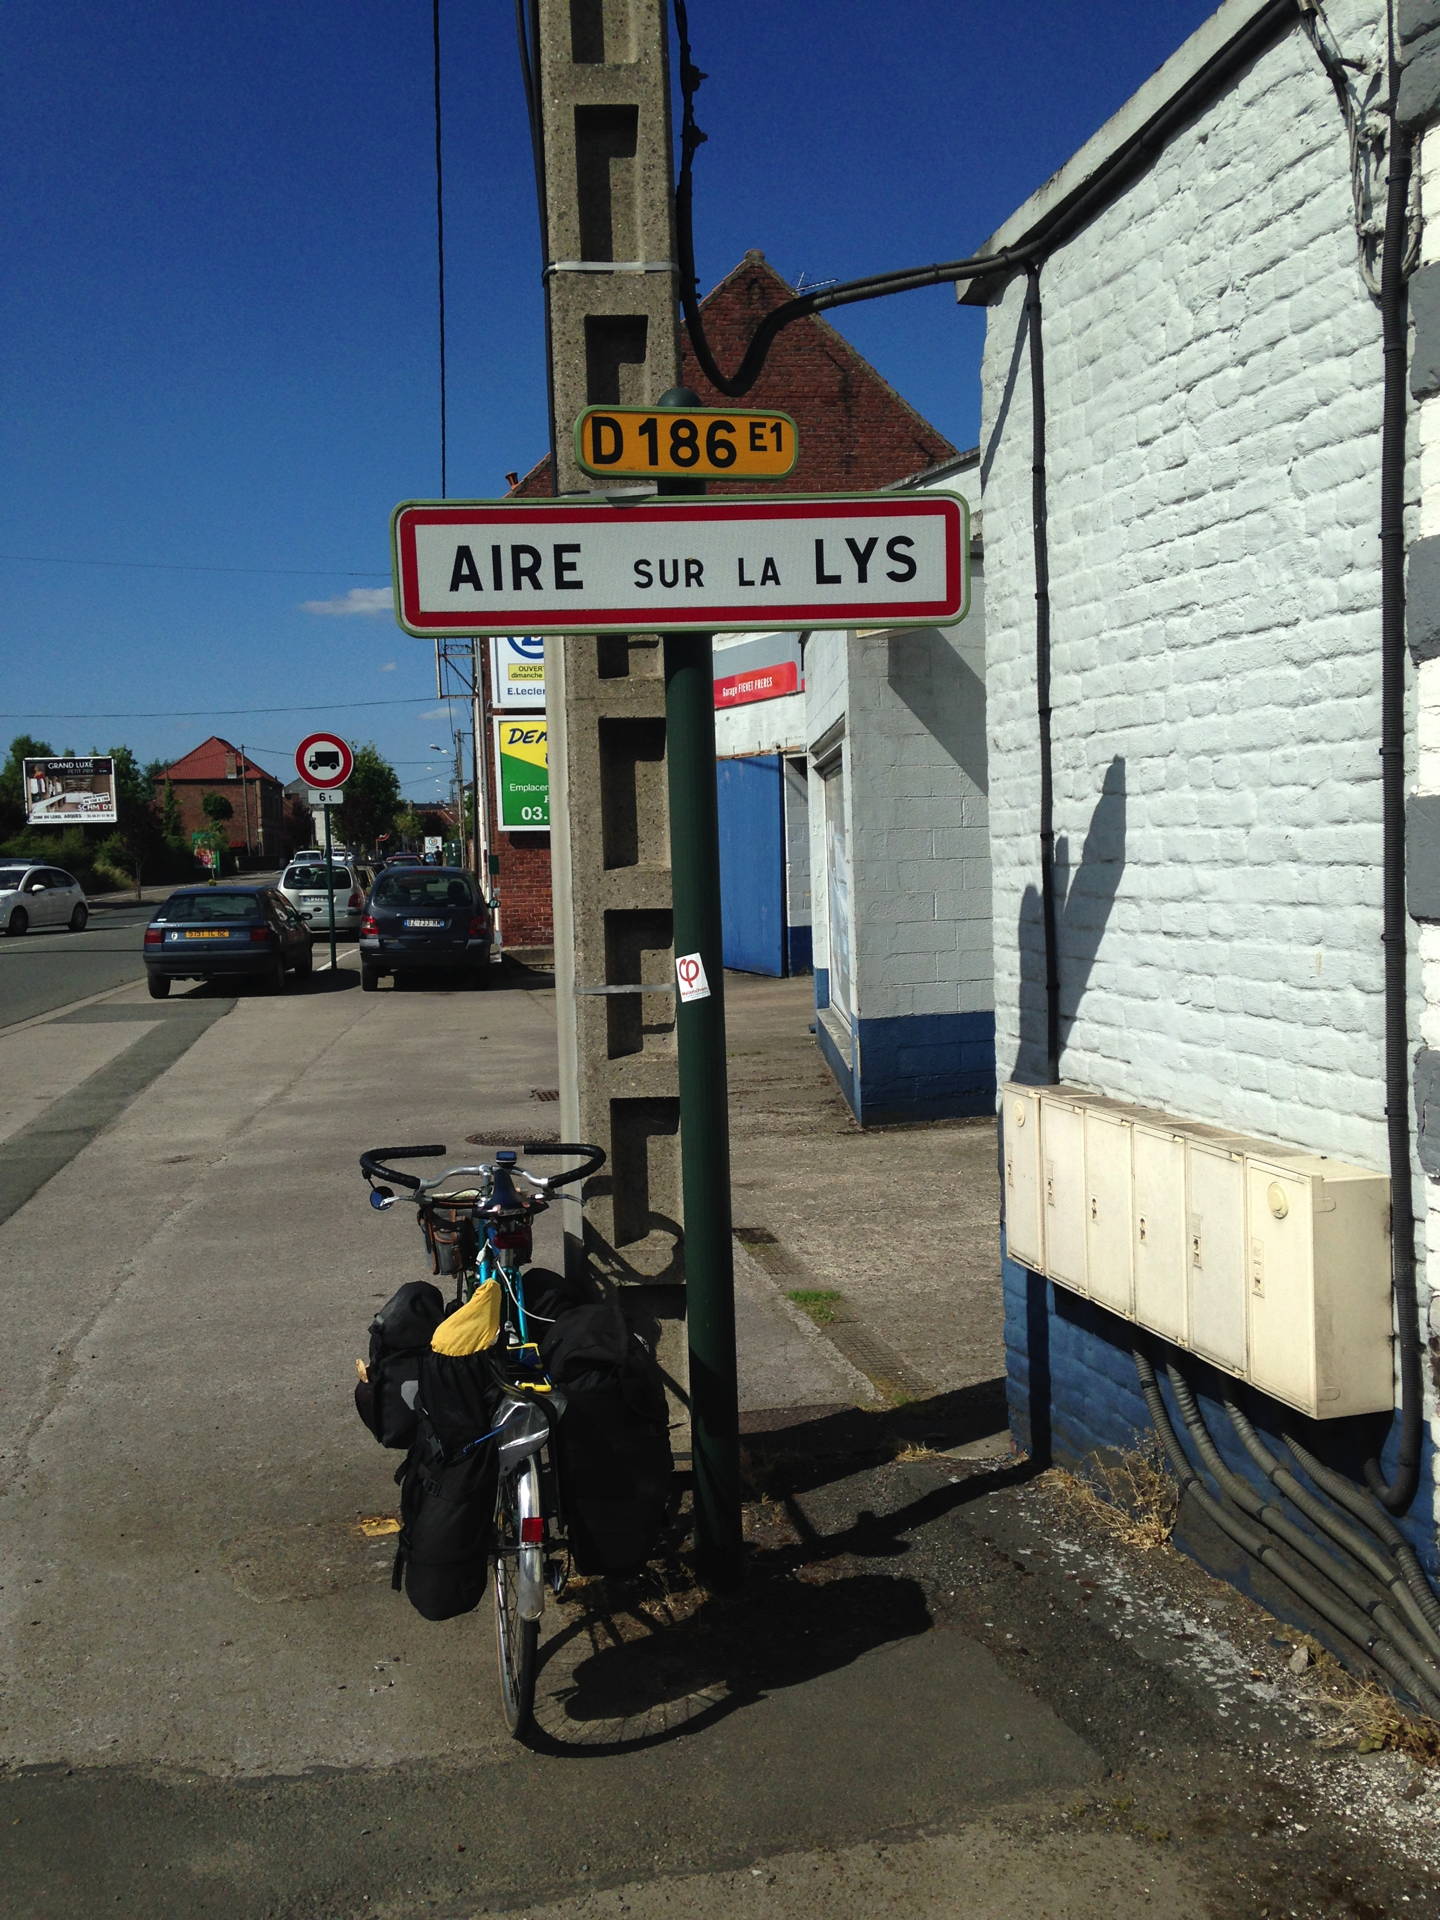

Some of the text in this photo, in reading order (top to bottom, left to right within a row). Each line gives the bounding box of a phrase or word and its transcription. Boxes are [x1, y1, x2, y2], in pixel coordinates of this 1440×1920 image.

[591, 416, 783, 468] D 186 E1
[449, 535, 918, 592] AIRE SUR LA LYS
[722, 687, 738, 697] Garage
[754, 676, 773, 690] FRERES
[318, 792, 333, 802] 6 t
